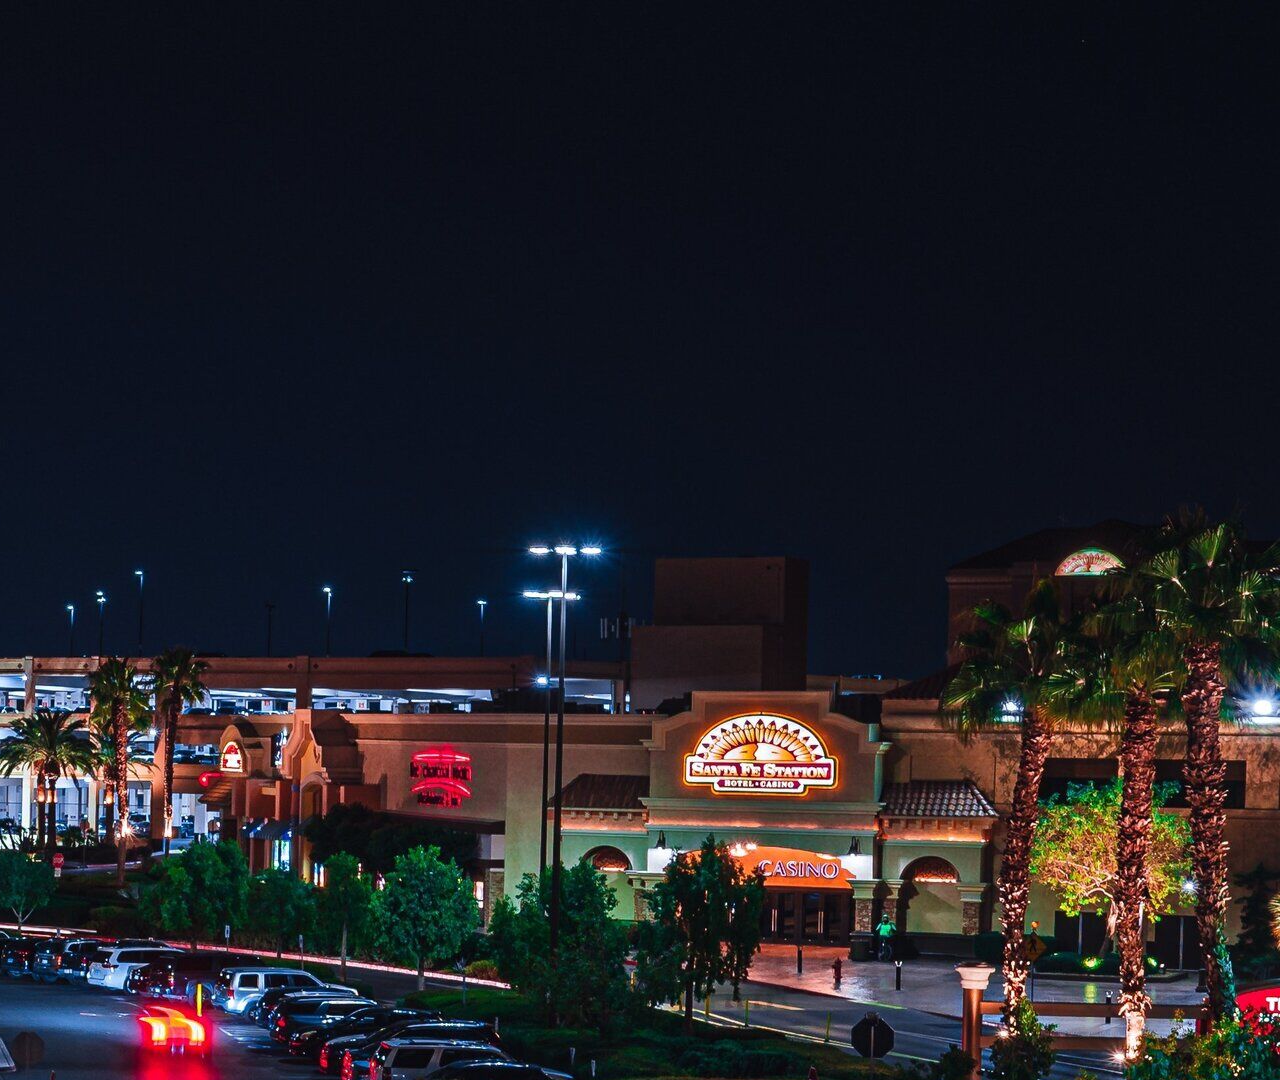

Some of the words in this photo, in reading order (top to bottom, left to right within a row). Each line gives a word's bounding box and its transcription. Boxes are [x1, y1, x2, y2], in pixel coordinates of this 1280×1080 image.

[691, 762, 739, 777] SANTA
[740, 763, 761, 777] FE
[763, 763, 829, 779] STATION
[724, 780, 754, 788] HOTEL
[760, 780, 795, 788] CASINO
[758, 859, 840, 879] CASINO
